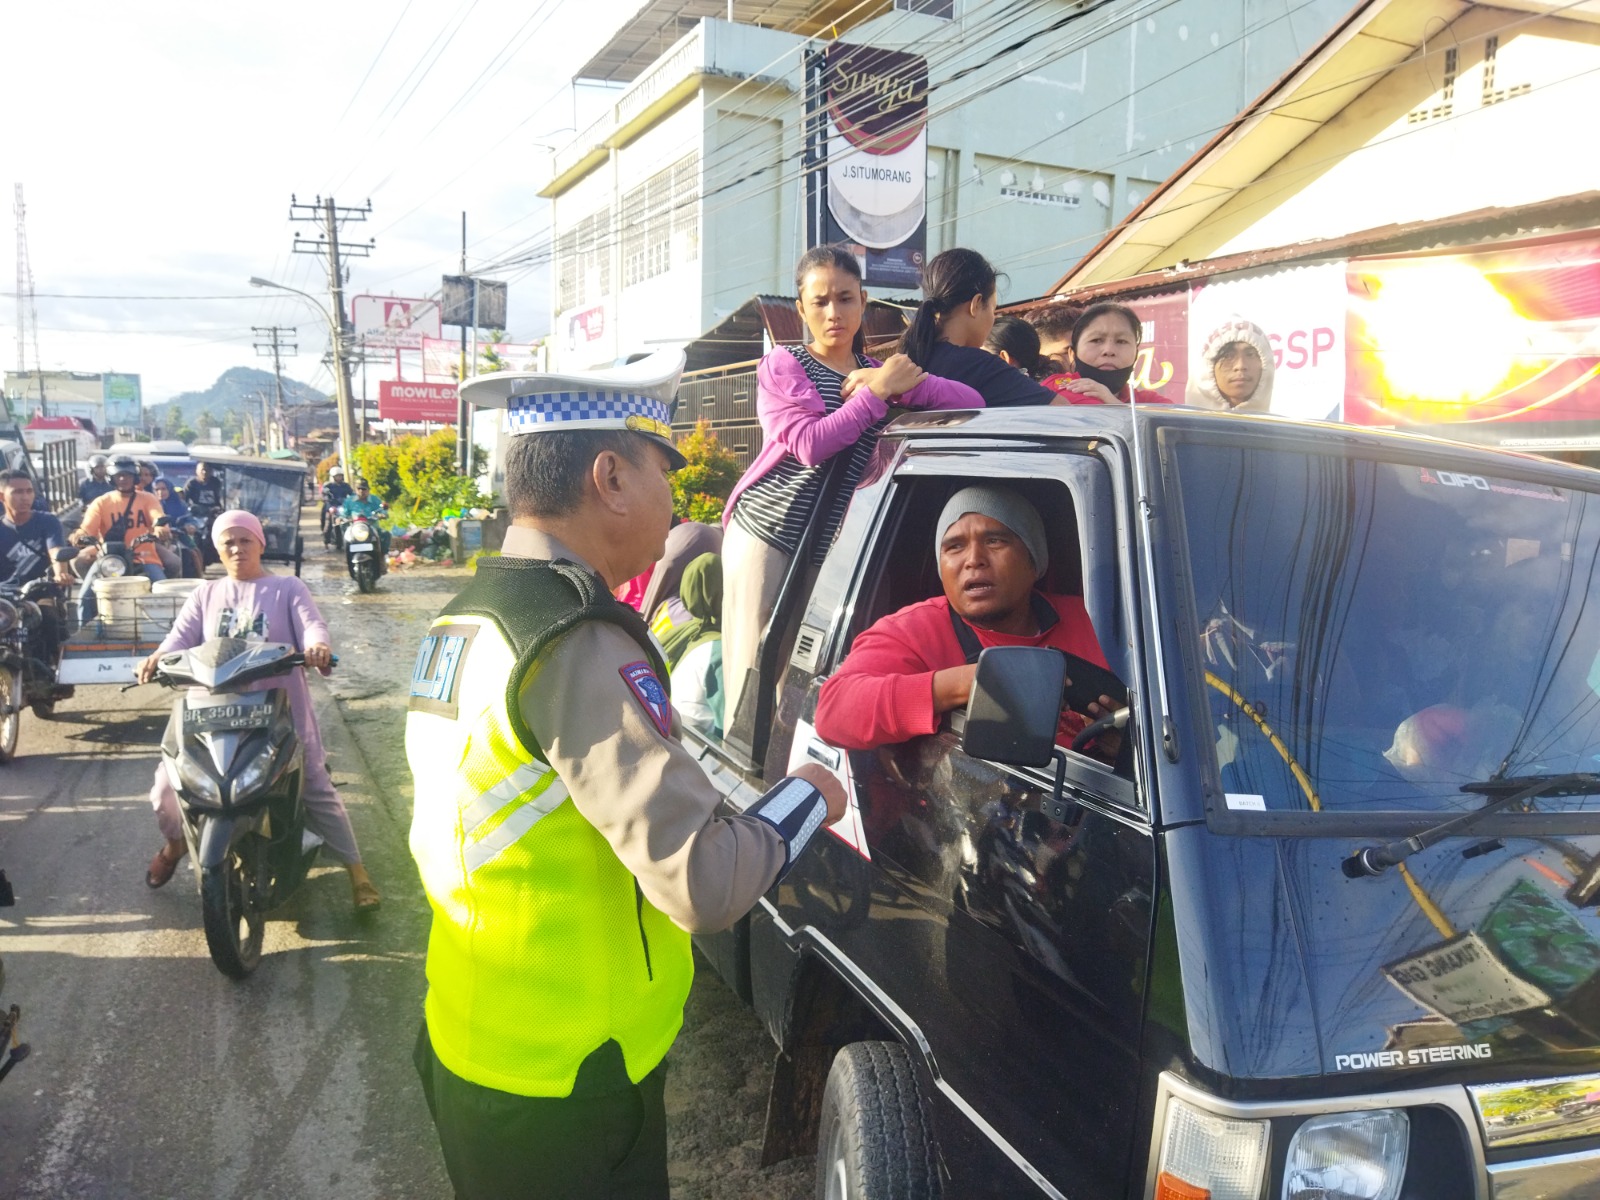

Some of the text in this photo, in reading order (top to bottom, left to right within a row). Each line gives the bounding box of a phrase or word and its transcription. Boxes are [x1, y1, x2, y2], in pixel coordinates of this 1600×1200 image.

[842, 164, 912, 184] J.SITUMORANG
[1437, 470, 1490, 491] DIPO
[1335, 1043, 1492, 1071] POWER STEERING
